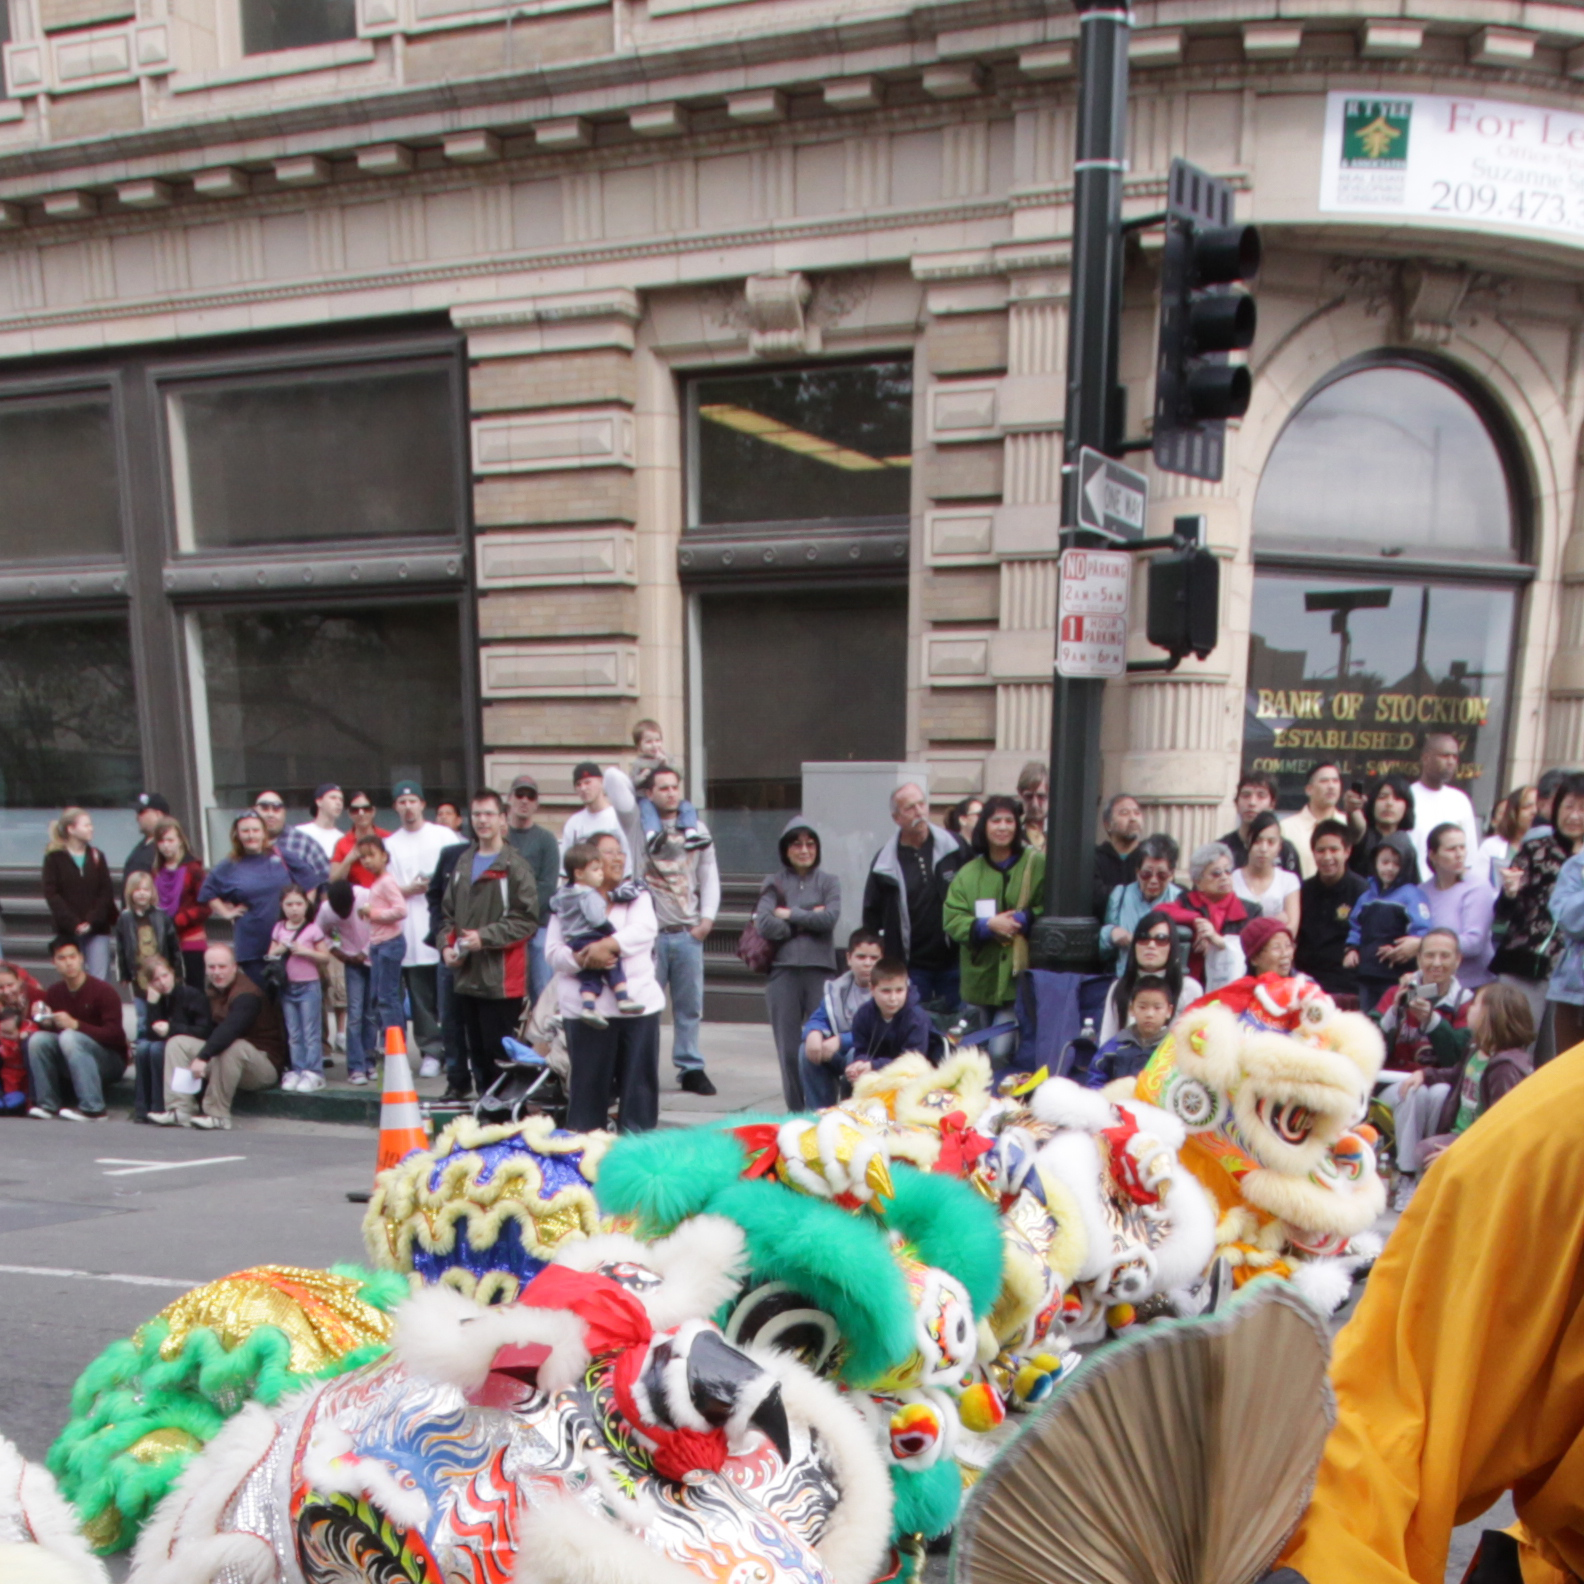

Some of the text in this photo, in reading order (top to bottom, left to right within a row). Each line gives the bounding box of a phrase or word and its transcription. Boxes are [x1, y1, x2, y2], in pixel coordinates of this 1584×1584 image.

[1444, 102, 1525, 141] For
[1471, 157, 1563, 188] Suzanne
[1104, 482, 1143, 526] ONE WAY
[1066, 554, 1127, 579] NO PARKING
[1083, 629, 1123, 646] PARKING
[1255, 688, 1491, 727] BANK OF STOCKTON
[1273, 727, 1415, 751] ESTABLISHED
